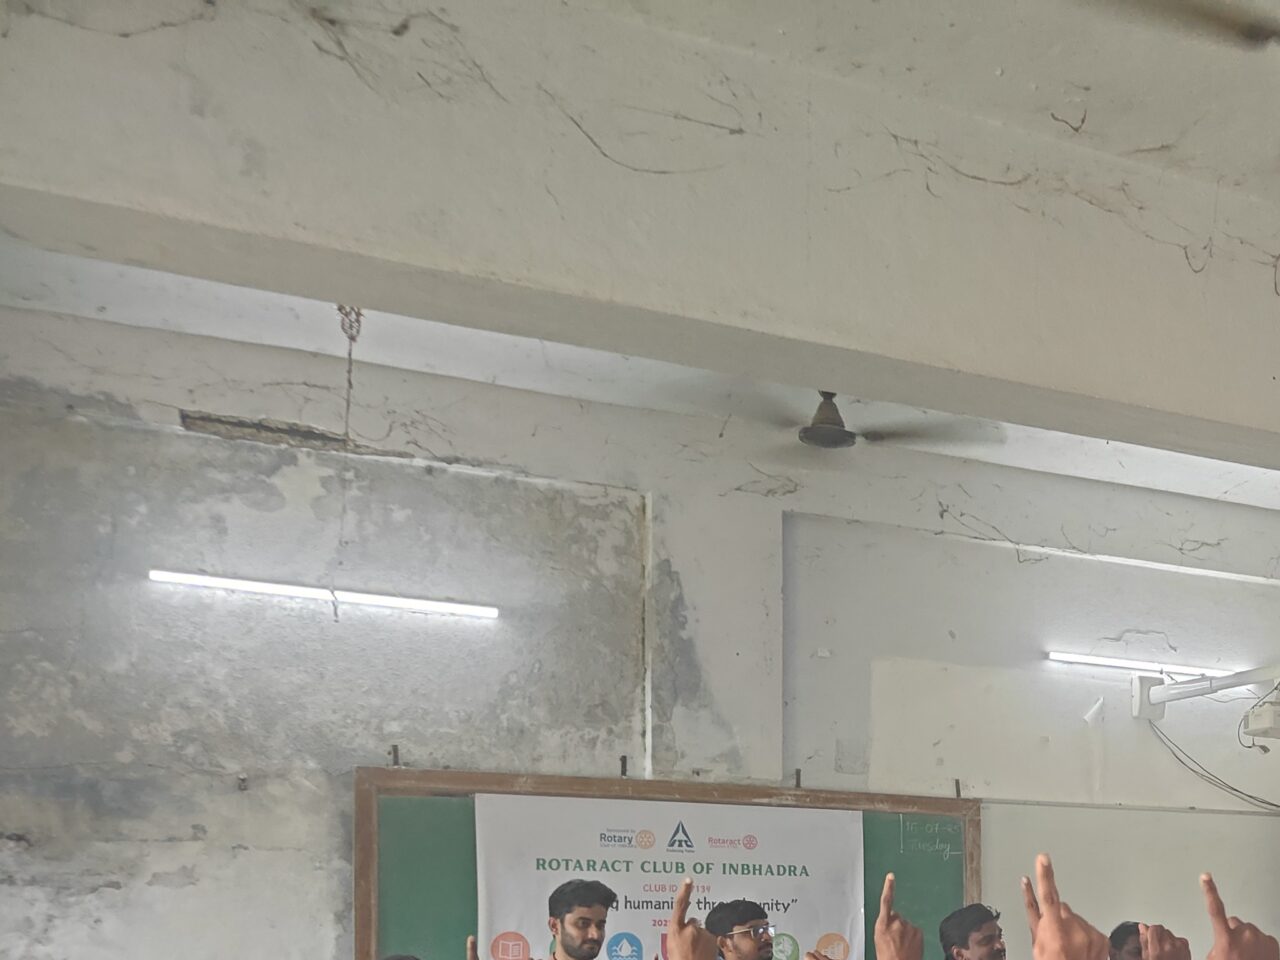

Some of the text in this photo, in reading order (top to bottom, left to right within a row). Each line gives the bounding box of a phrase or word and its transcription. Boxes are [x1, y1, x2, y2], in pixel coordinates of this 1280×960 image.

[600, 833, 633, 845] Rotary
[708, 837, 741, 846] Rotaract
[536, 858, 810, 877] ROTARACT CLUB OF INBHADRA
[643, 884, 667, 892] CLUB
[669, 884, 678, 892] ID
[624, 896, 691, 911] humani
